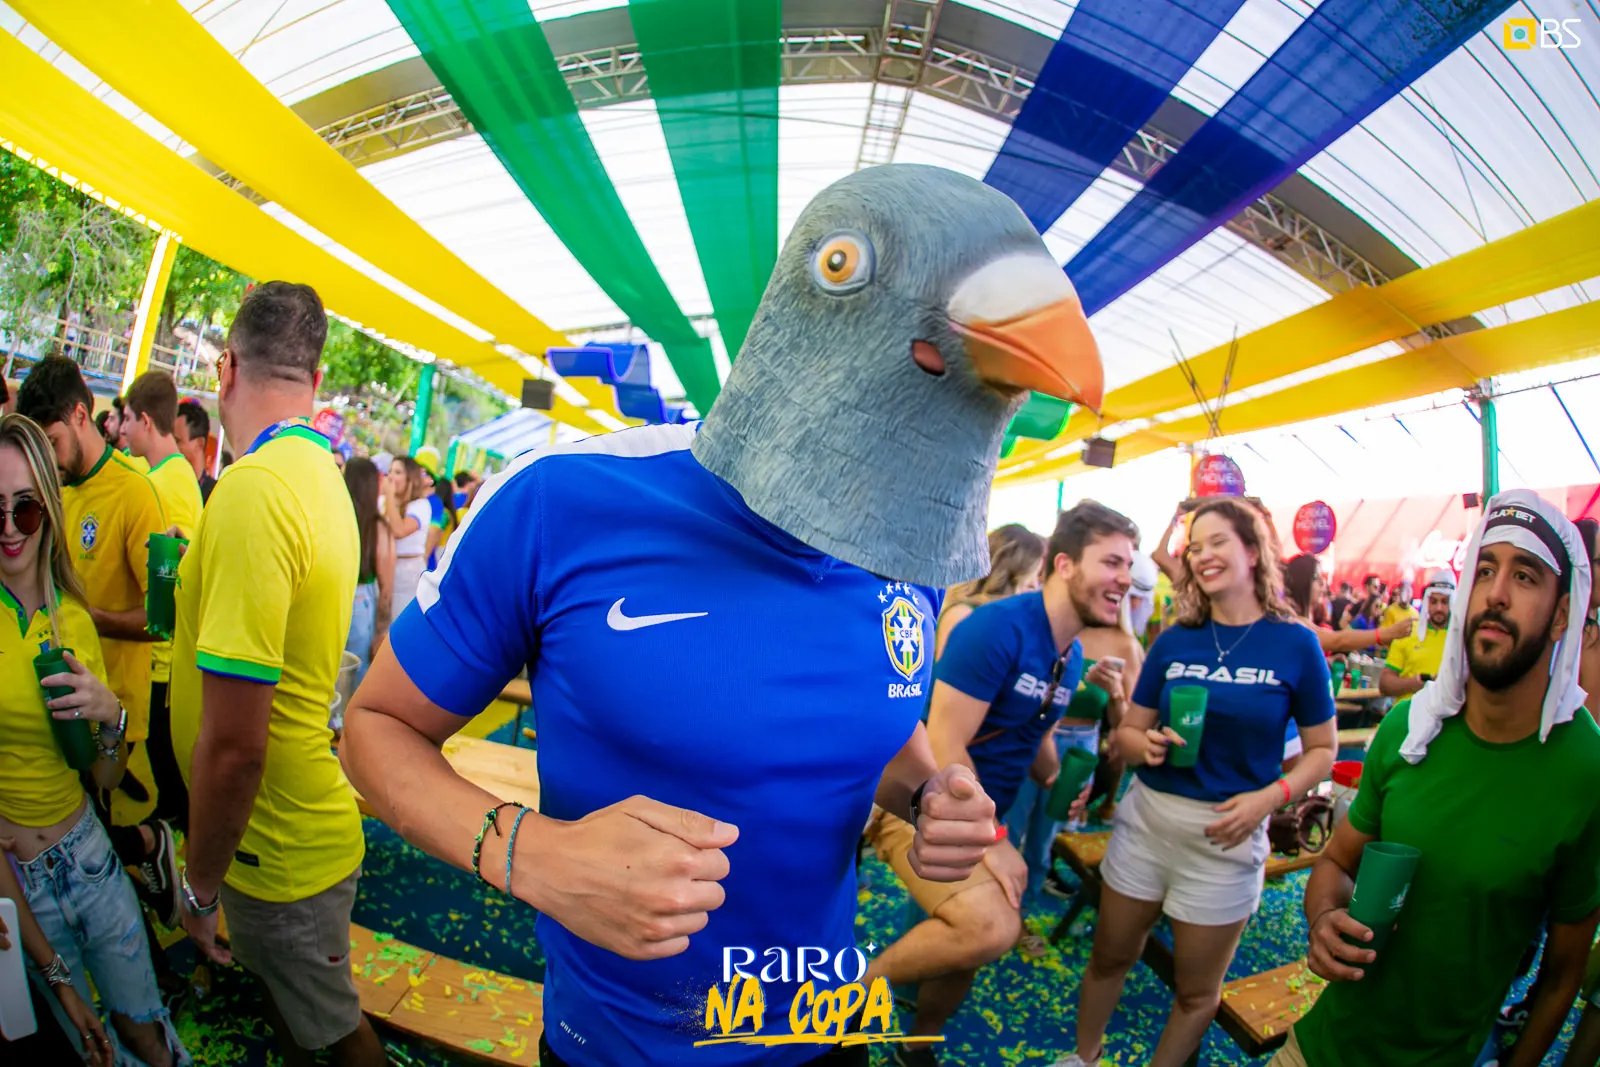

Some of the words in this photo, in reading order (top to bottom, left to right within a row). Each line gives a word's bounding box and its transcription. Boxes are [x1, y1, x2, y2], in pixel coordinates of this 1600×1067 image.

[1165, 661, 1281, 686] BRASIL
[888, 683, 922, 698] BRASIL
[1014, 672, 1071, 706] BRSI
